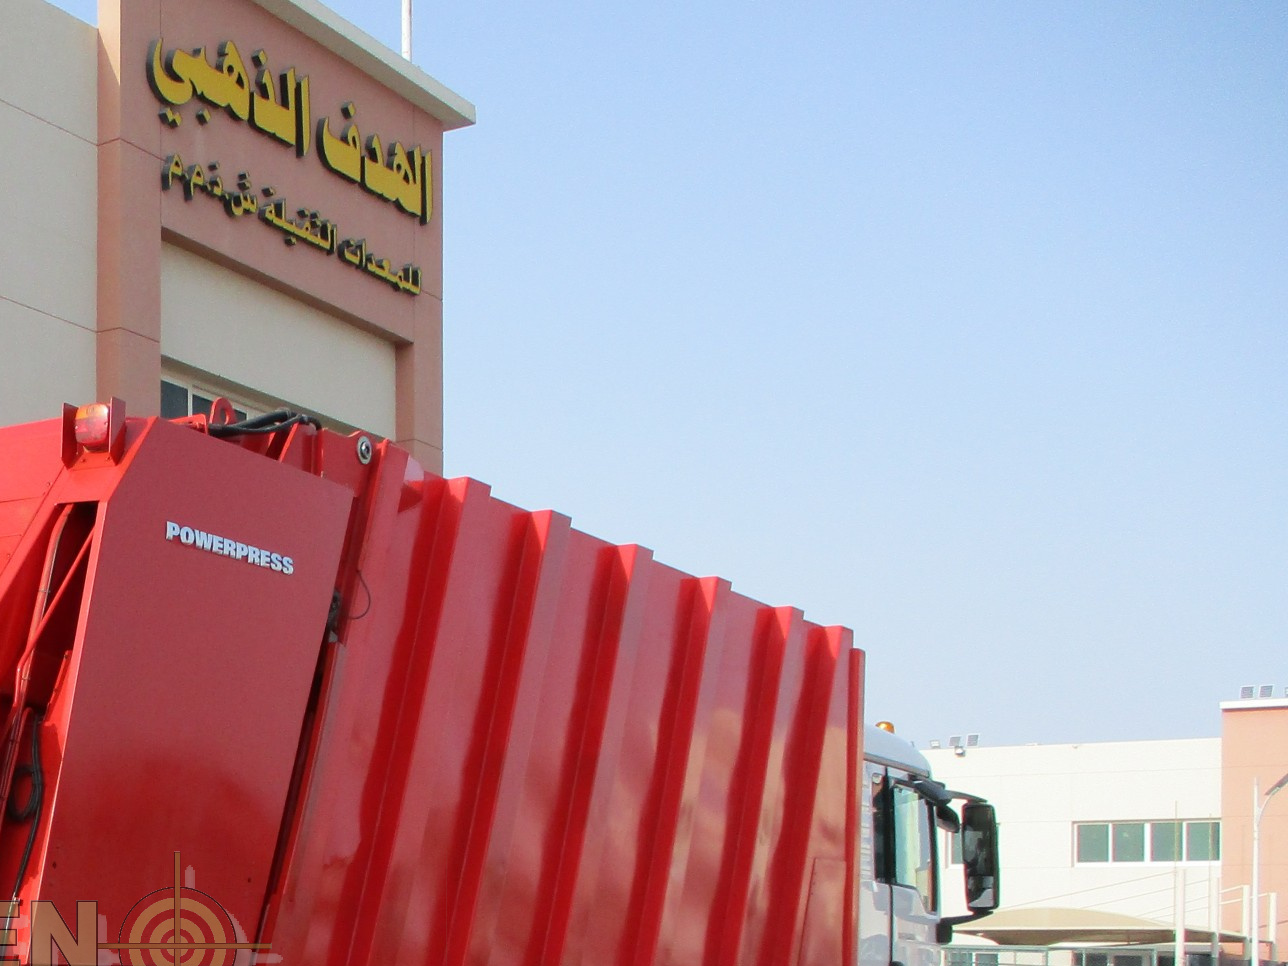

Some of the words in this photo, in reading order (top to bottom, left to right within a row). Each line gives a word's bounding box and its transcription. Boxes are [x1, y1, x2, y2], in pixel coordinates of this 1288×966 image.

[146, 38, 310, 157] الذهبي
[316, 101, 432, 225] الهدف
[166, 520, 294, 575] POWERPRESS
